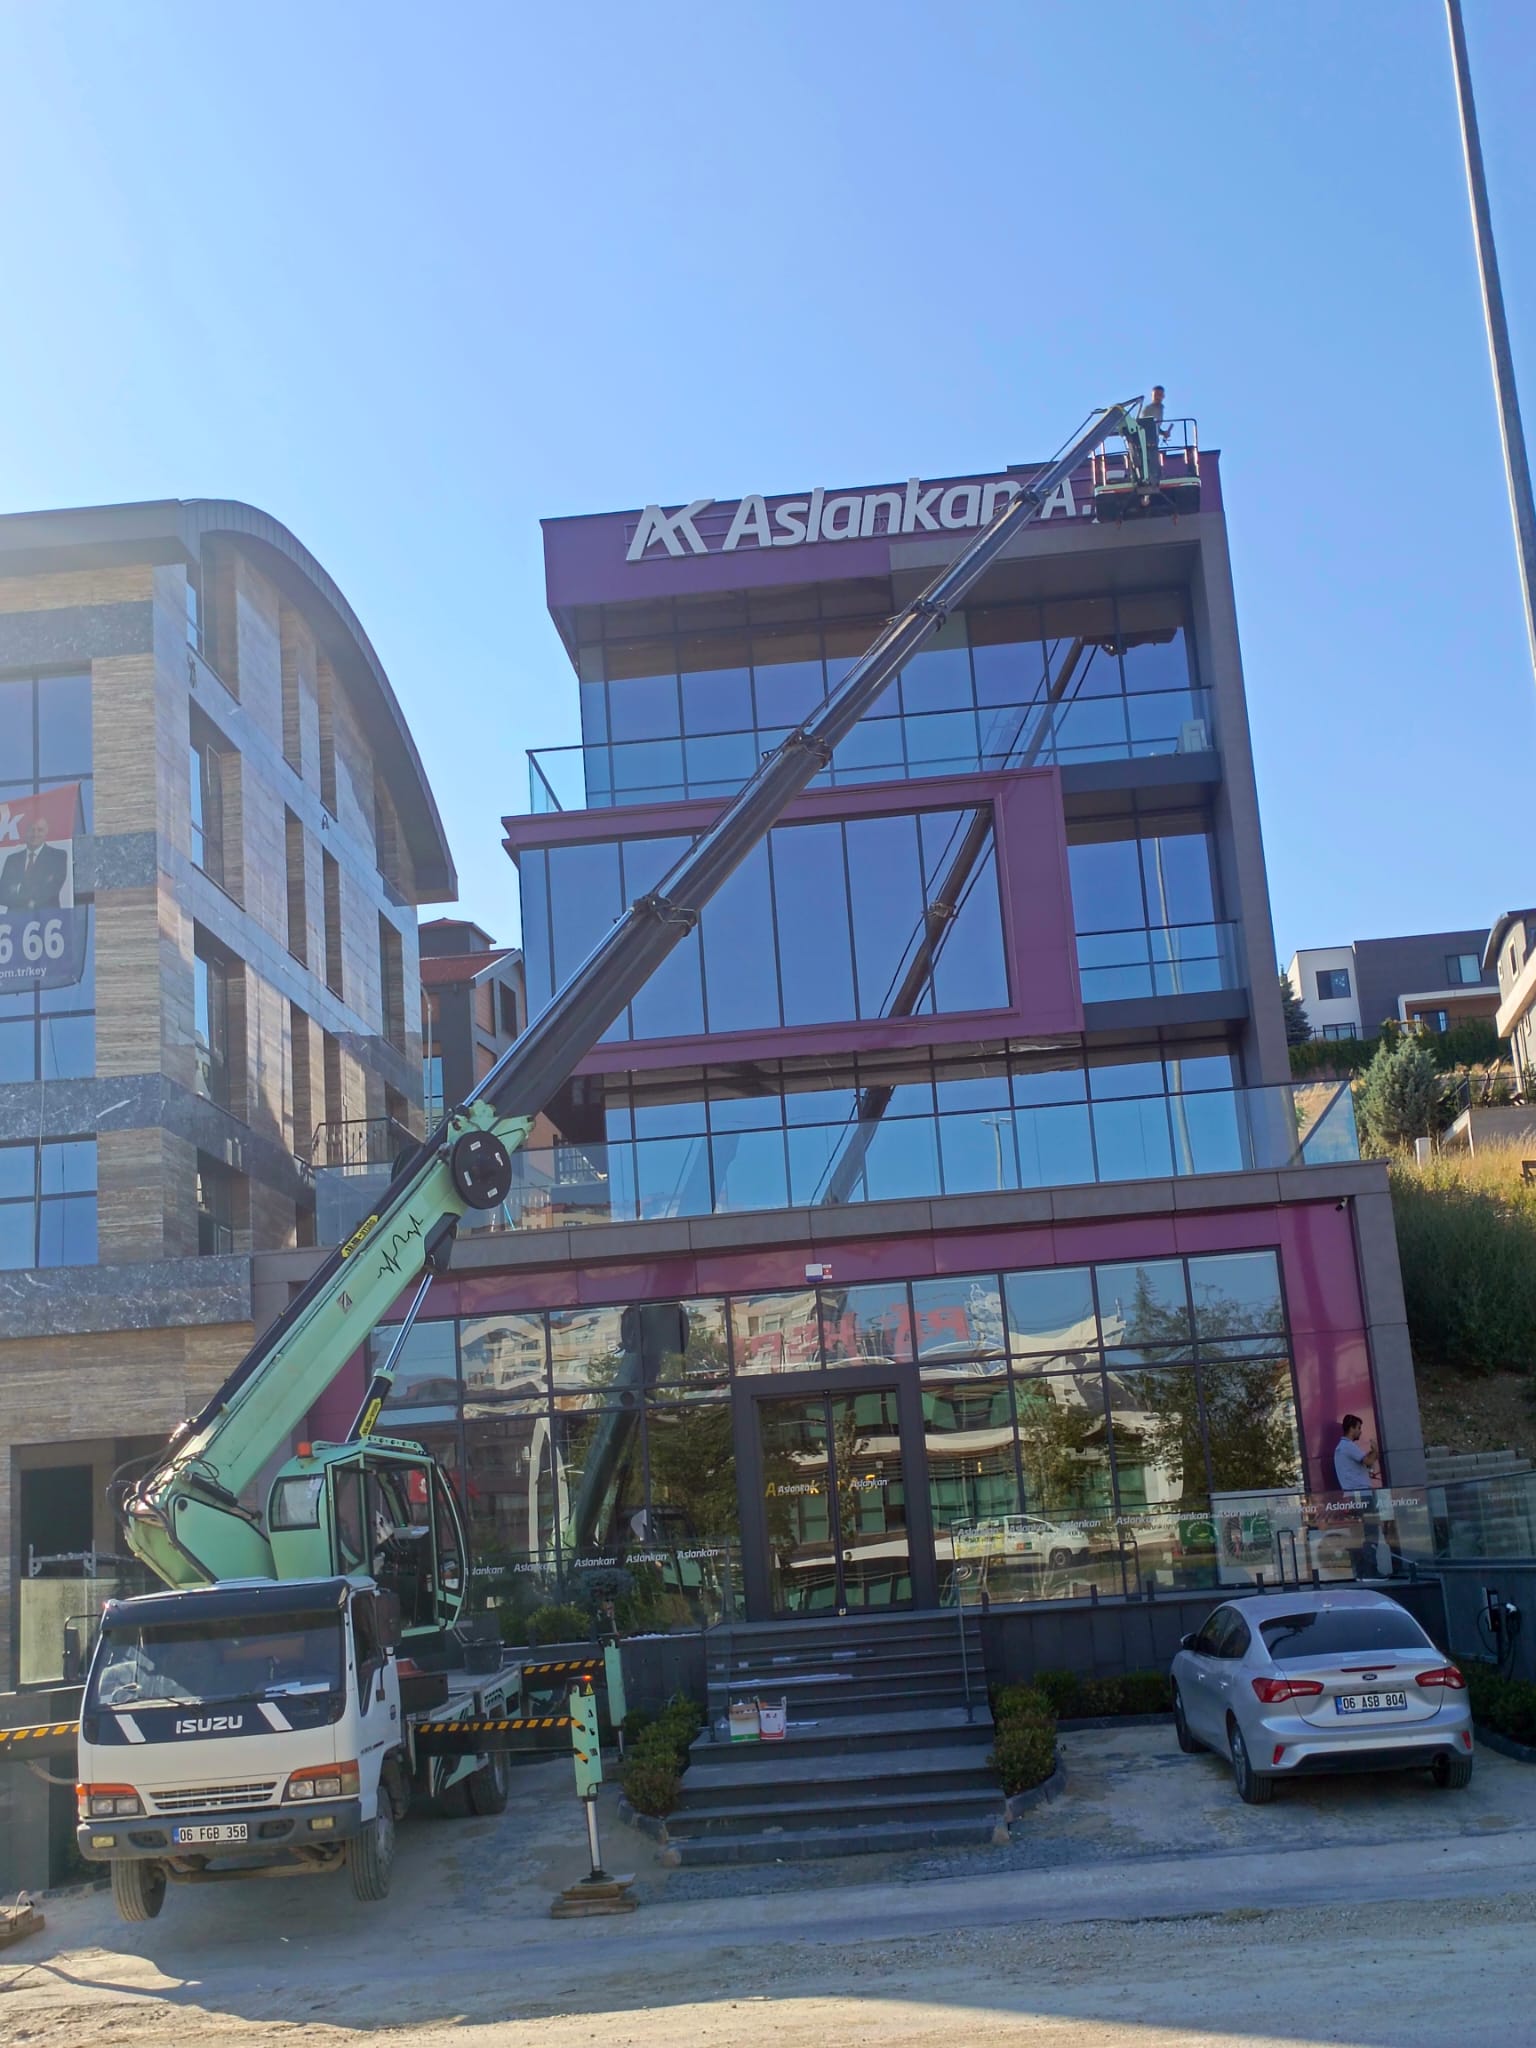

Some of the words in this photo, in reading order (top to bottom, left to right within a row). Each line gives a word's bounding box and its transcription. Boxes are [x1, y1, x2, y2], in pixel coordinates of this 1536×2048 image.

[722, 478, 1023, 550] Aslankan
[23, 919, 64, 961] 66
[1325, 1499, 1367, 1511] Aslankan
[574, 1557, 615, 1568] Aslankan
[626, 1553, 667, 1563] Aslankan
[677, 1548, 718, 1559] Aslankan
[1342, 1697, 1356, 1709] 06
[1361, 1695, 1380, 1708] ASB
[1385, 1693, 1404, 1706] 804
[175, 1715, 243, 1734] ISUZU
[180, 1828, 193, 1842] 06
[199, 1826, 220, 1840] FGB
[226, 1825, 247, 1838] 358
